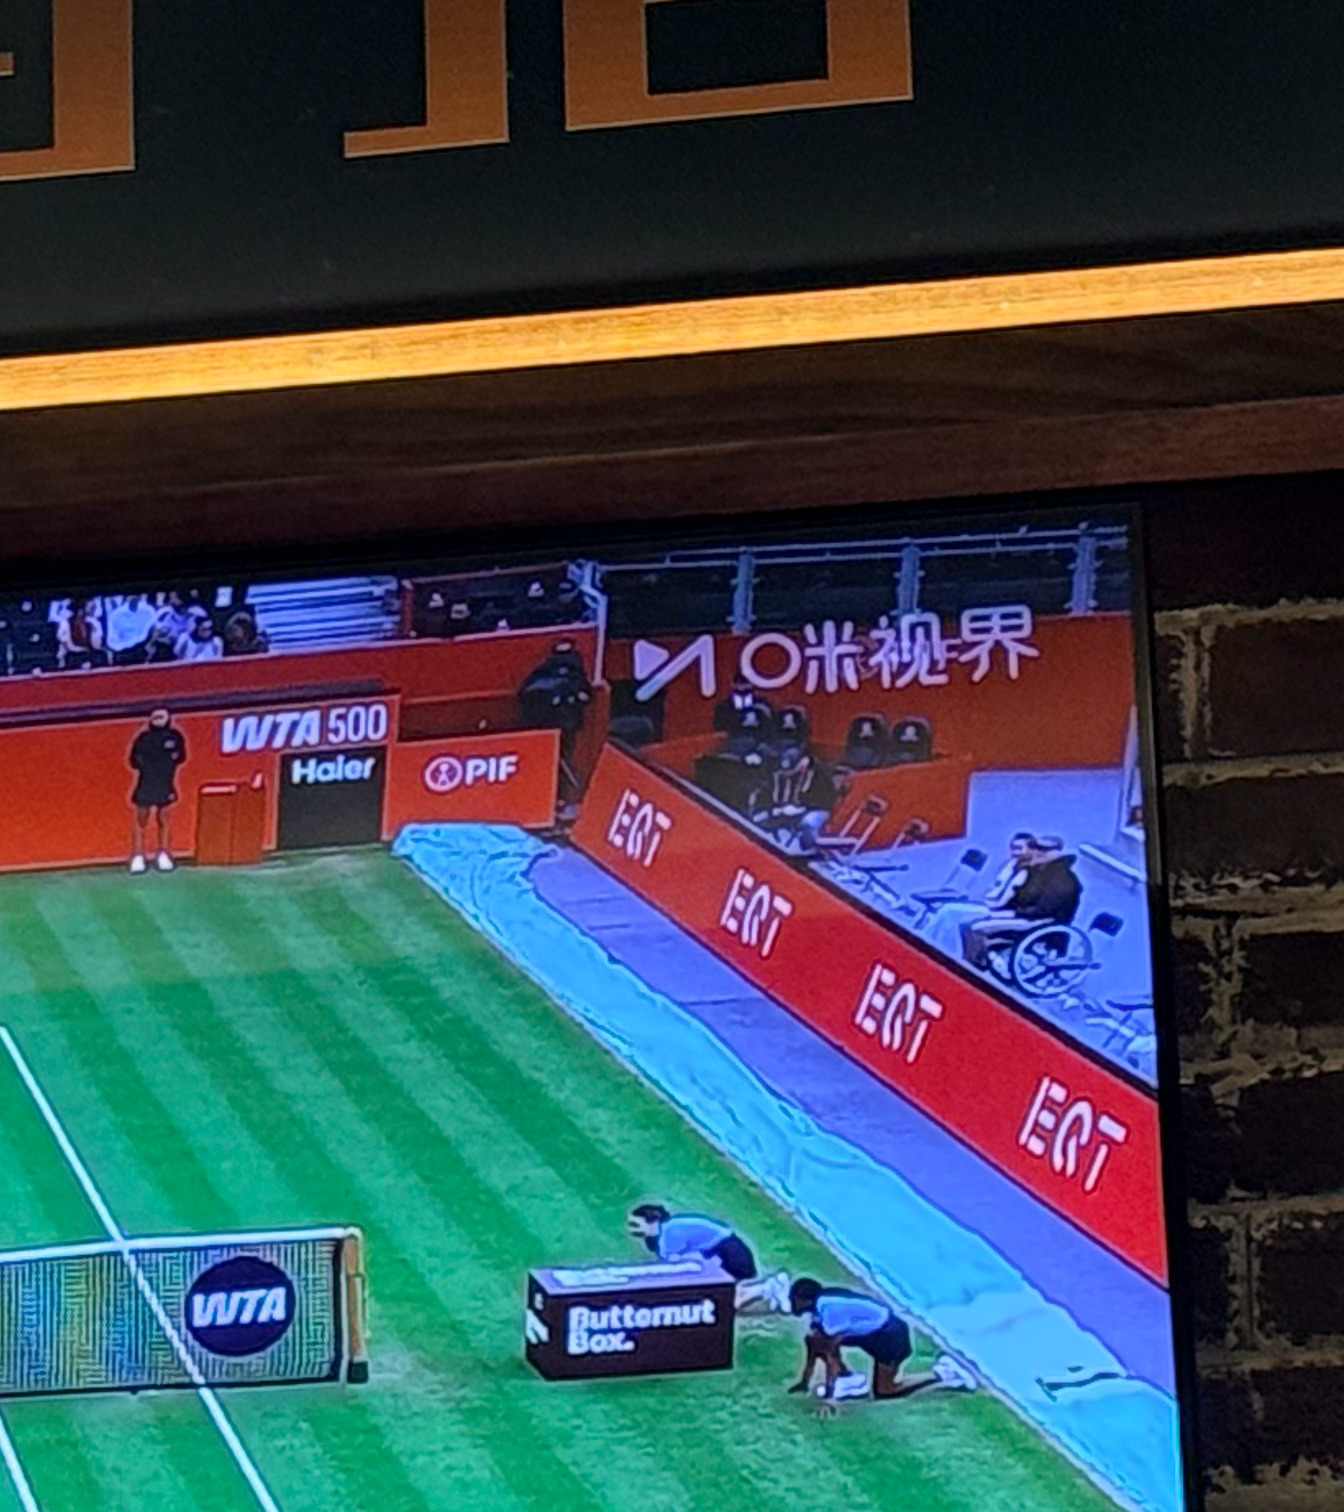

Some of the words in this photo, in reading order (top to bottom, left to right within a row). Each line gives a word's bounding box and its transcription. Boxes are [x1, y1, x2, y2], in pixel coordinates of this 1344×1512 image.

[220, 710, 321, 753] WTA
[326, 704, 388, 744] 500
[291, 755, 376, 785] Haier
[465, 754, 520, 784] PIF
[191, 1285, 287, 1329] WTA
